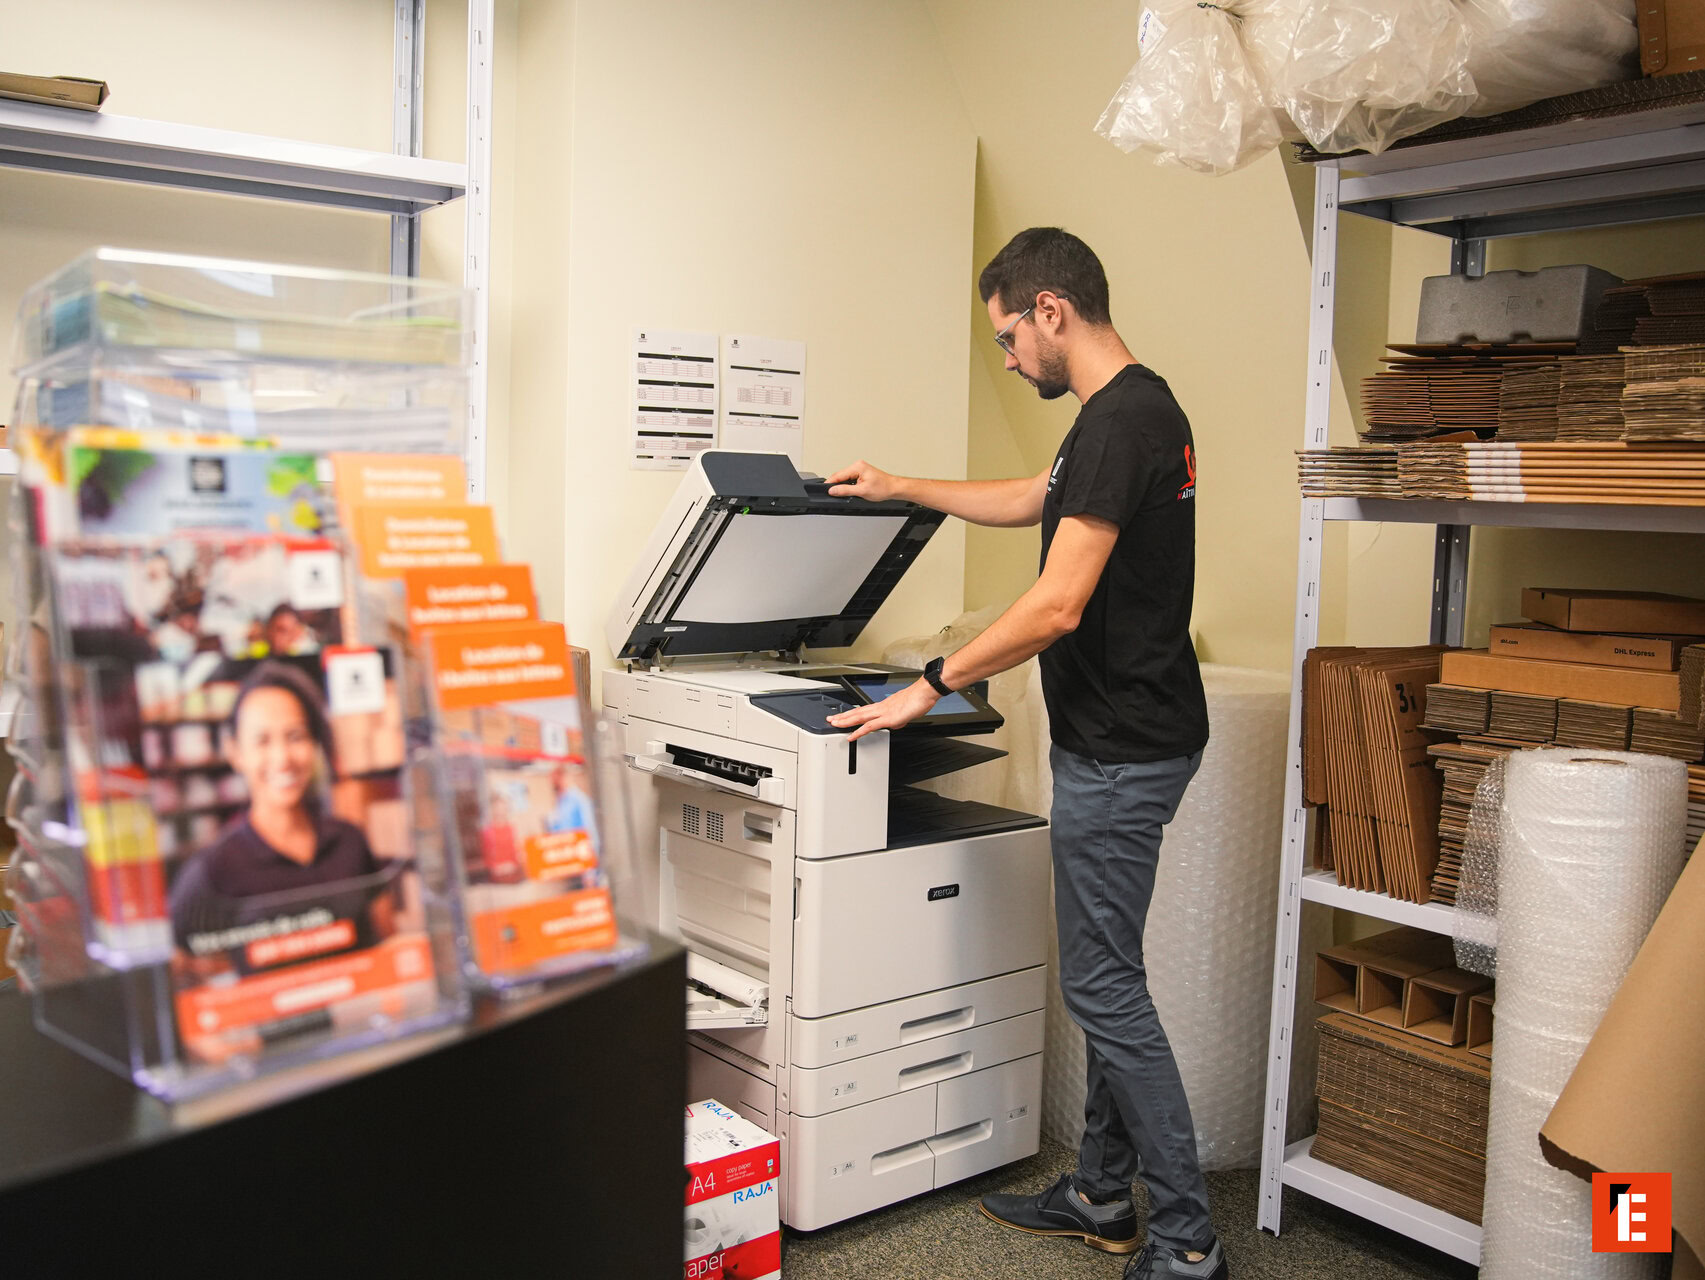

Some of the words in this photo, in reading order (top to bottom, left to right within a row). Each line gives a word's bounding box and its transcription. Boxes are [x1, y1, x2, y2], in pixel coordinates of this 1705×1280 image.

[1614, 647, 1628, 655] DHL
[1629, 649, 1656, 657] Express
[932, 887, 956, 898] xerox
[835, 1040, 839, 1048] 1
[834, 1088, 839, 1096] 2
[702, 1102, 734, 1121] RAJA
[833, 1167, 838, 1176] 3
[692, 1172, 717, 1197] A4
[733, 1181, 774, 1204] RAJA
